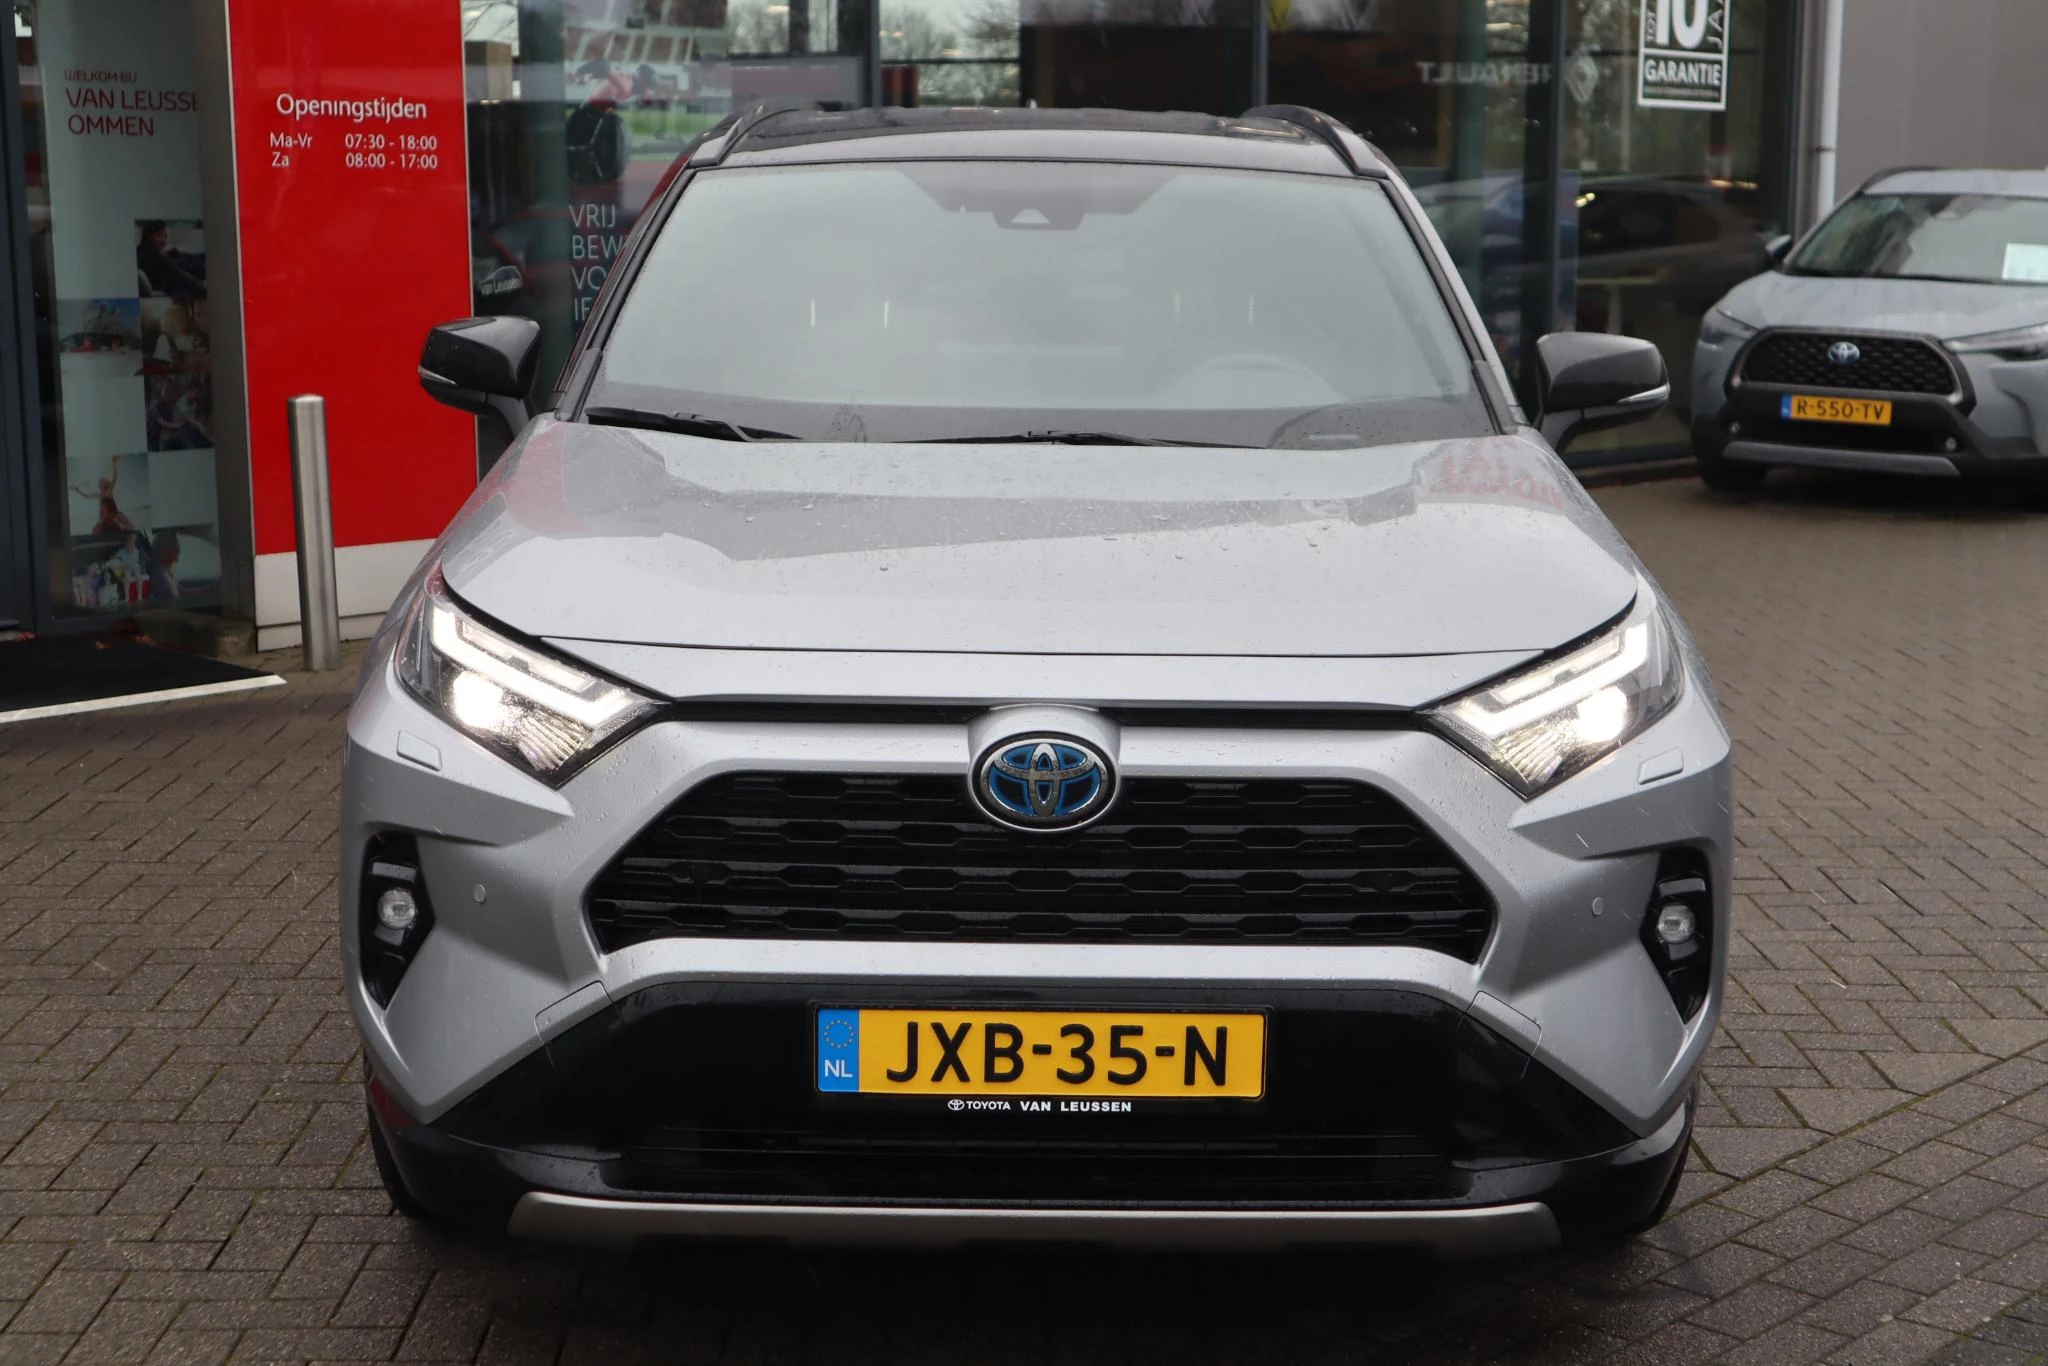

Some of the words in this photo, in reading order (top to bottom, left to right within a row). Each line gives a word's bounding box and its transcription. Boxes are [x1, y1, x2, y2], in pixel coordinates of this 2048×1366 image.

[1655, 0, 1709, 49] 10
[64, 70, 117, 82] WELKOM
[1644, 59, 1721, 85] GARANTIE
[65, 88, 115, 109] VAN
[276, 93, 427, 124] Openingstijden
[68, 114, 154, 137] OMMEN
[269, 132, 313, 149] Ma-Vr
[344, 133, 385, 149] 07:30
[400, 135, 437, 150] 18:00
[271, 152, 290, 167] Za
[345, 153, 386, 168] 08:00
[400, 154, 438, 169] 17:00
[569, 204, 616, 228] VRIJ
[571, 235, 627, 259] BEW
[1796, 398, 1885, 420] R-550-TV
[886, 1021, 1228, 1086] JXB-35-N
[824, 1059, 852, 1078] NL
[966, 1101, 1011, 1111] TOYOTA
[1020, 1101, 1051, 1112] VAN
[1060, 1102, 1132, 1112] LEUSSEN
